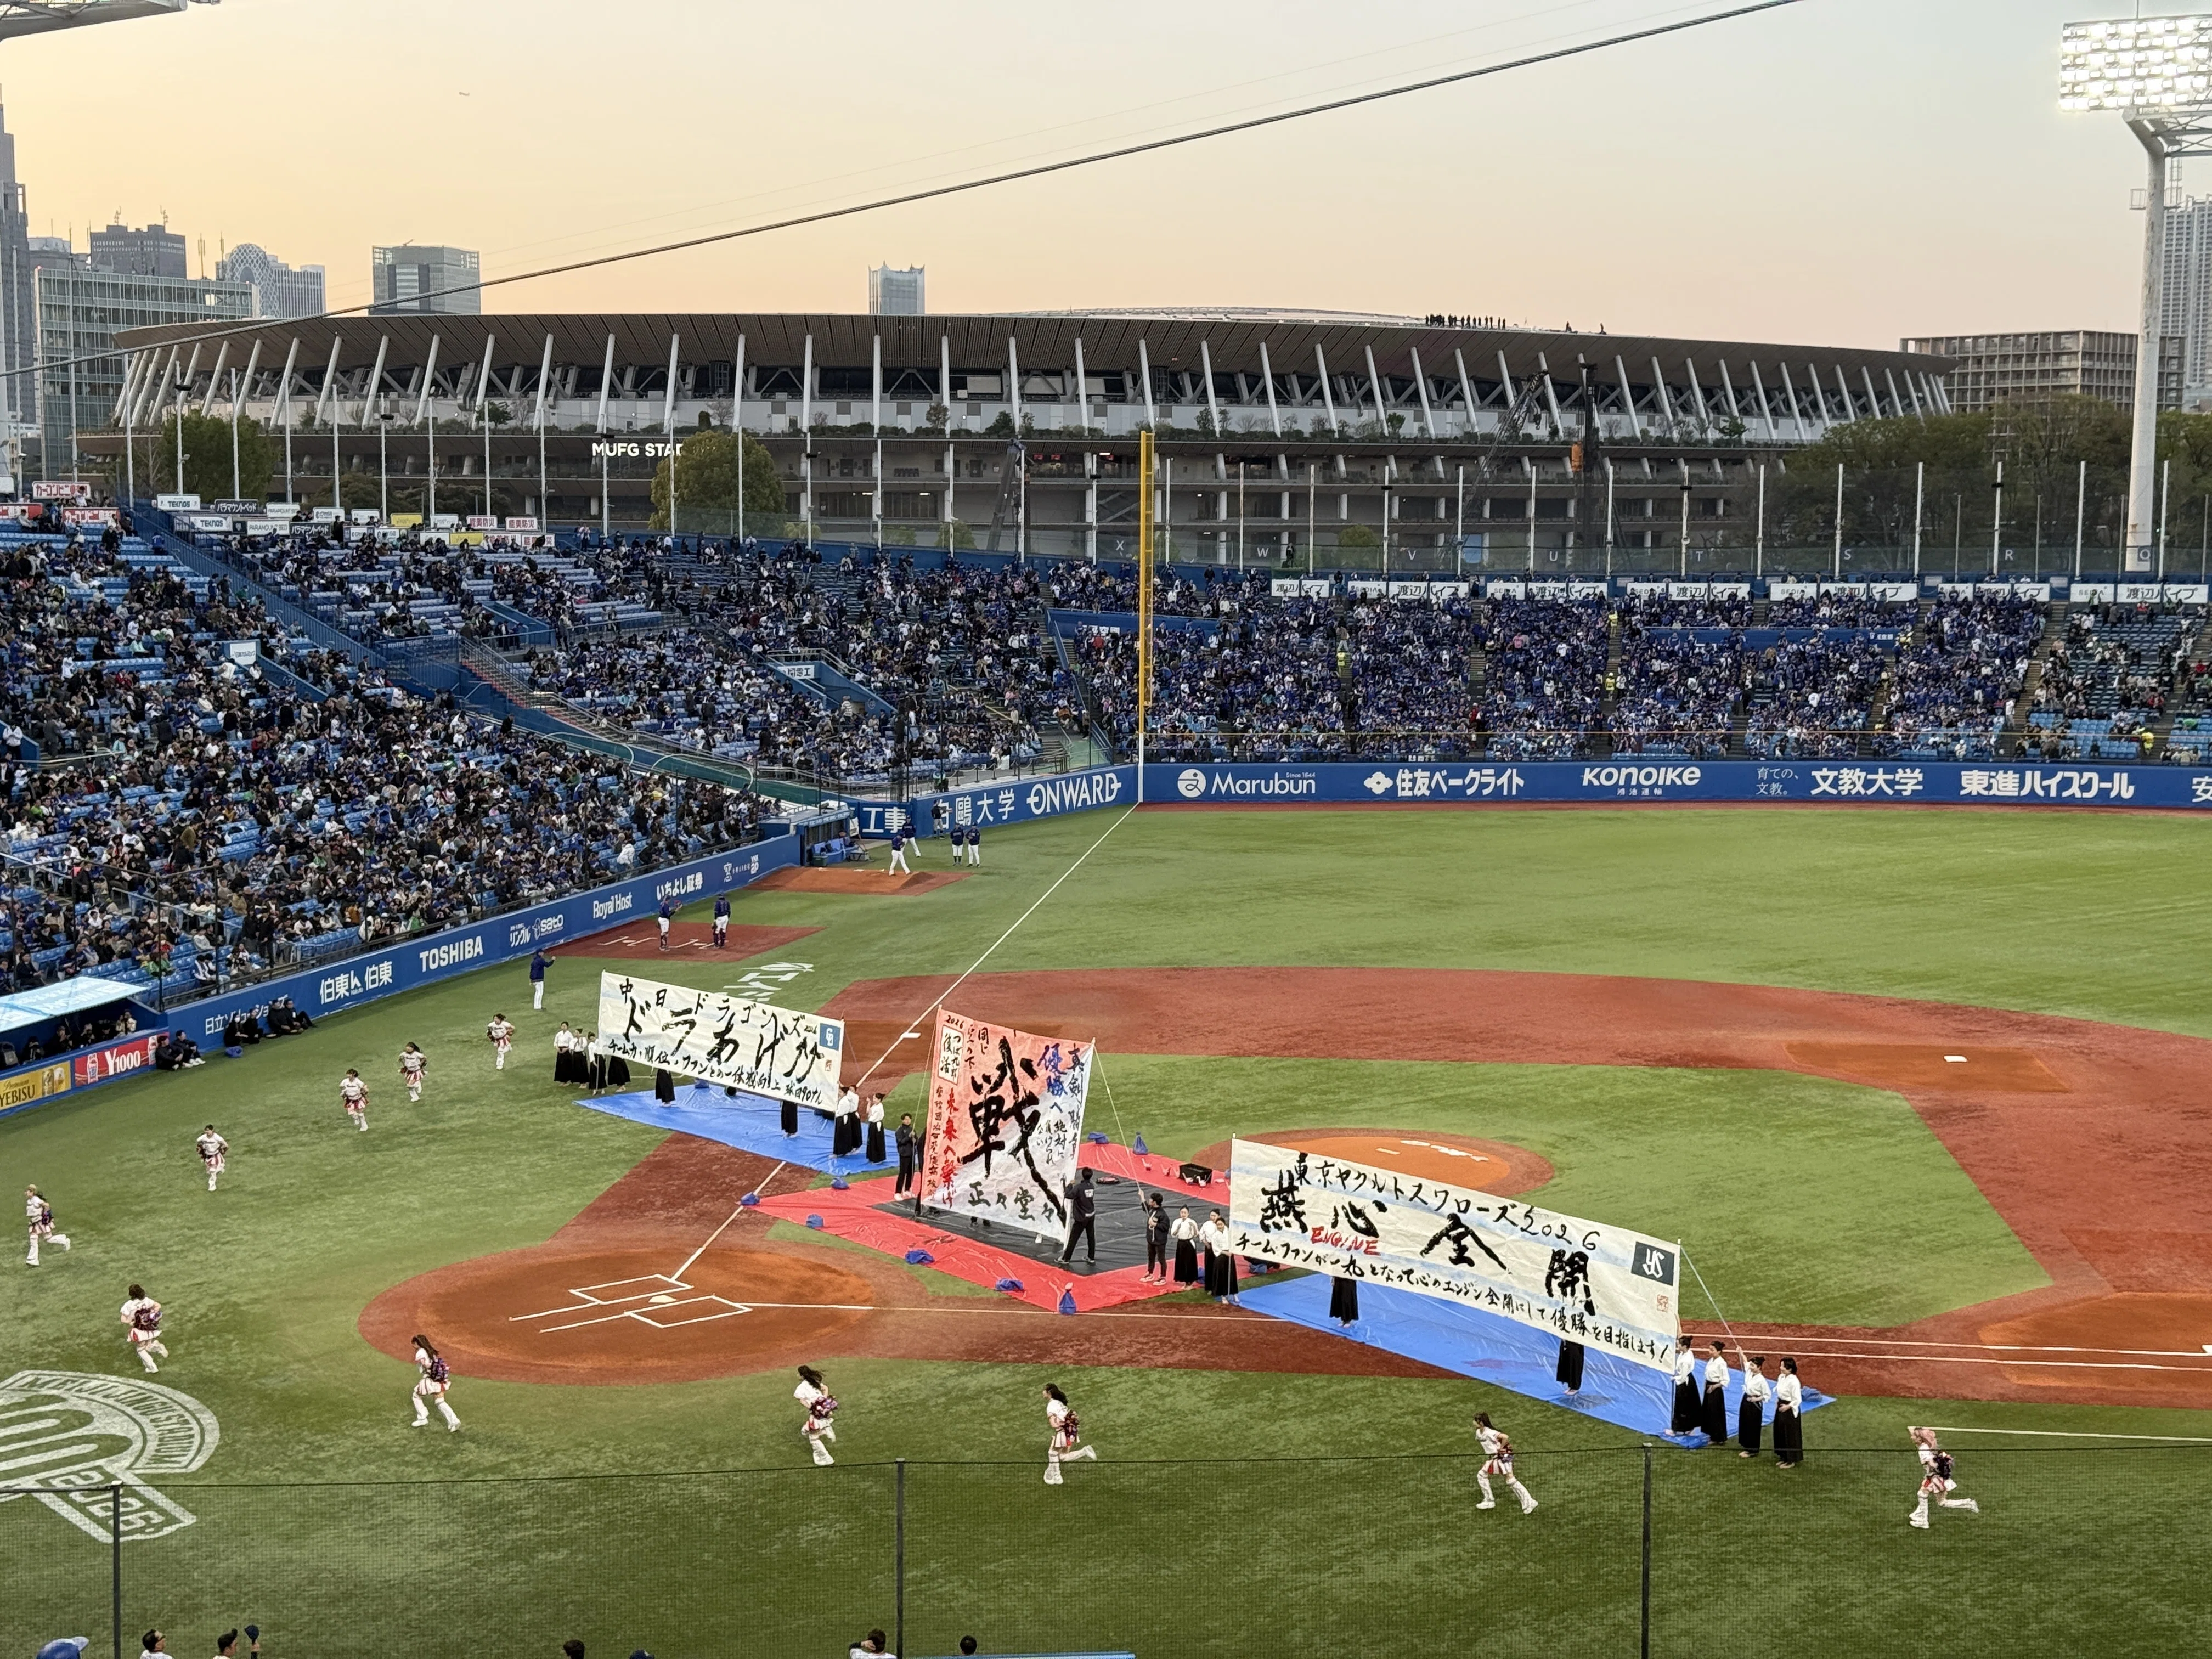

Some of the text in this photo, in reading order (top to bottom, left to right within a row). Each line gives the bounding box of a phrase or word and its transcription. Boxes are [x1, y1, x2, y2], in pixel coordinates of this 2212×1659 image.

[592, 443, 640, 457] MUFG
[217, 501, 257, 513] パラマウントベッド
[1116, 540, 1125, 551] X
[1257, 548, 1269, 558] W
[1408, 550, 1417, 560] V
[1549, 551, 1558, 562] U
[1695, 551, 1703, 562] T
[1843, 549, 1852, 561] S
[2005, 549, 2014, 561] R
[1276, 583, 1324, 592] 渡辺パイプ
[1397, 584, 1460, 599] 渡辺パイプ
[1677, 586, 1742, 599] 渡辺パイプ
[2126, 587, 2199, 600] 渡辺パイプ
[1026, 772, 1122, 815] ONWARD
[1211, 771, 1316, 795] Marubun
[1396, 768, 1525, 797] 住友ベークライト
[1810, 768, 1923, 796] 文教大学
[1960, 770, 2135, 799] 東進ハイスクール
[2192, 776, 2212, 803] 安
[862, 806, 906, 833] 工事
[657, 871, 703, 900] いちよし証券
[593, 891, 632, 920] Royal Host
[540, 914, 563, 932] sato
[420, 936, 483, 972] TOSHIBA
[364, 961, 393, 991] 伯東
[320, 973, 350, 1005] 伯東
[945, 1015, 965, 1029] 2026
[105, 1048, 141, 1075] Y1000
[968, 1181, 1054, 1222] 正々堂々
[1259, 1169, 1596, 1316] 燕心全開
[1310, 1226, 1382, 1257] ENGINE
[145, 1414, 195, 1465] STADIUM
